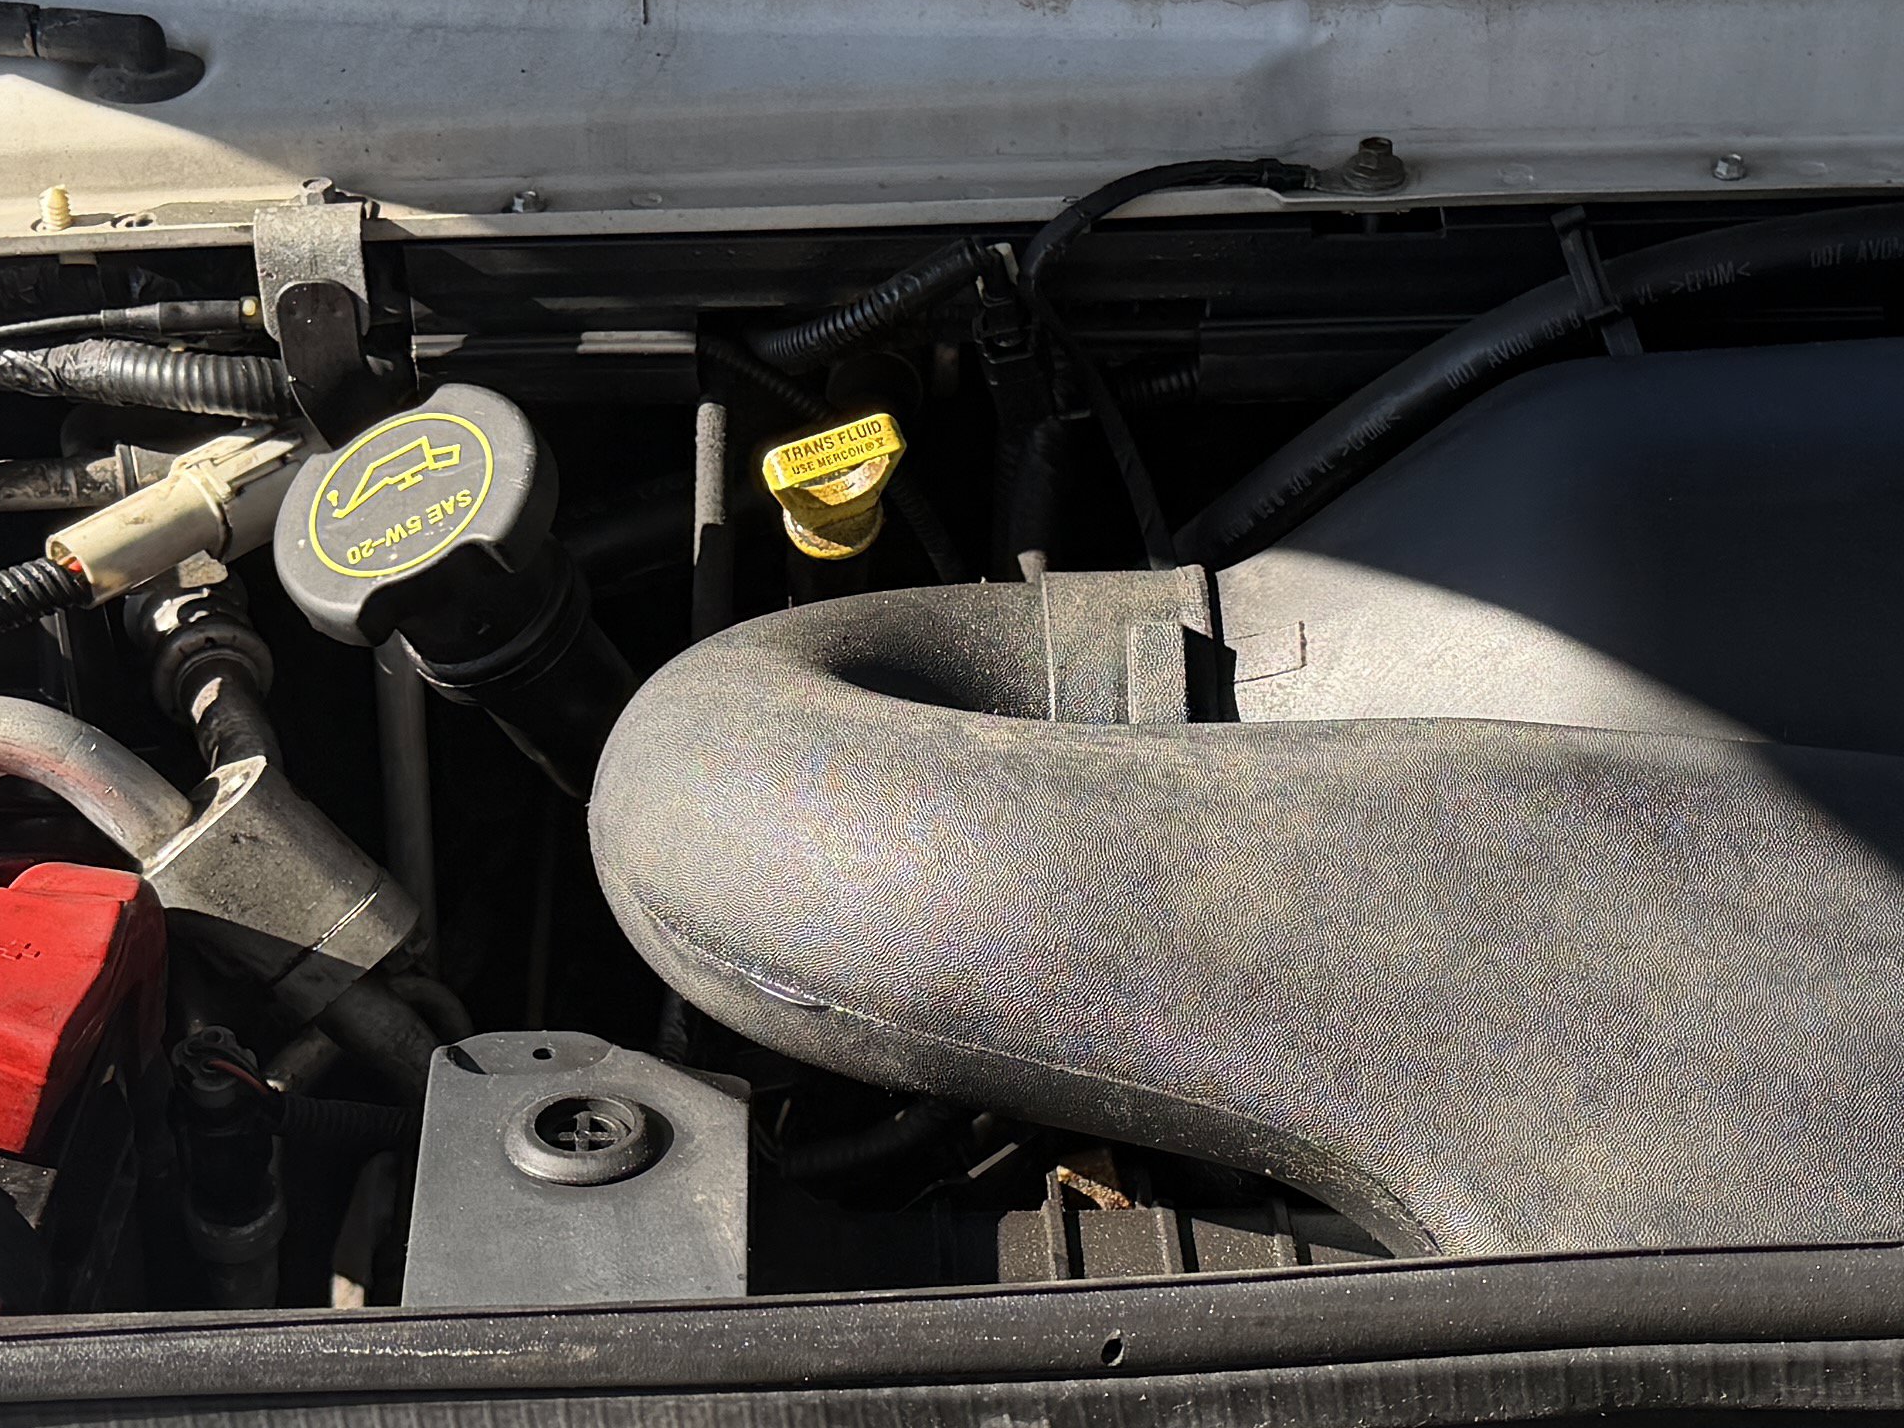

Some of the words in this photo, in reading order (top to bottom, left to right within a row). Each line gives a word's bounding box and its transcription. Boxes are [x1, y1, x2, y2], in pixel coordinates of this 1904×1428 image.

[782, 435, 835, 462] TRANS
[838, 420, 882, 445] FLUID
[791, 461, 816, 475] USE
[426, 488, 473, 525] SAE
[347, 515, 423, 565] 5W-20
